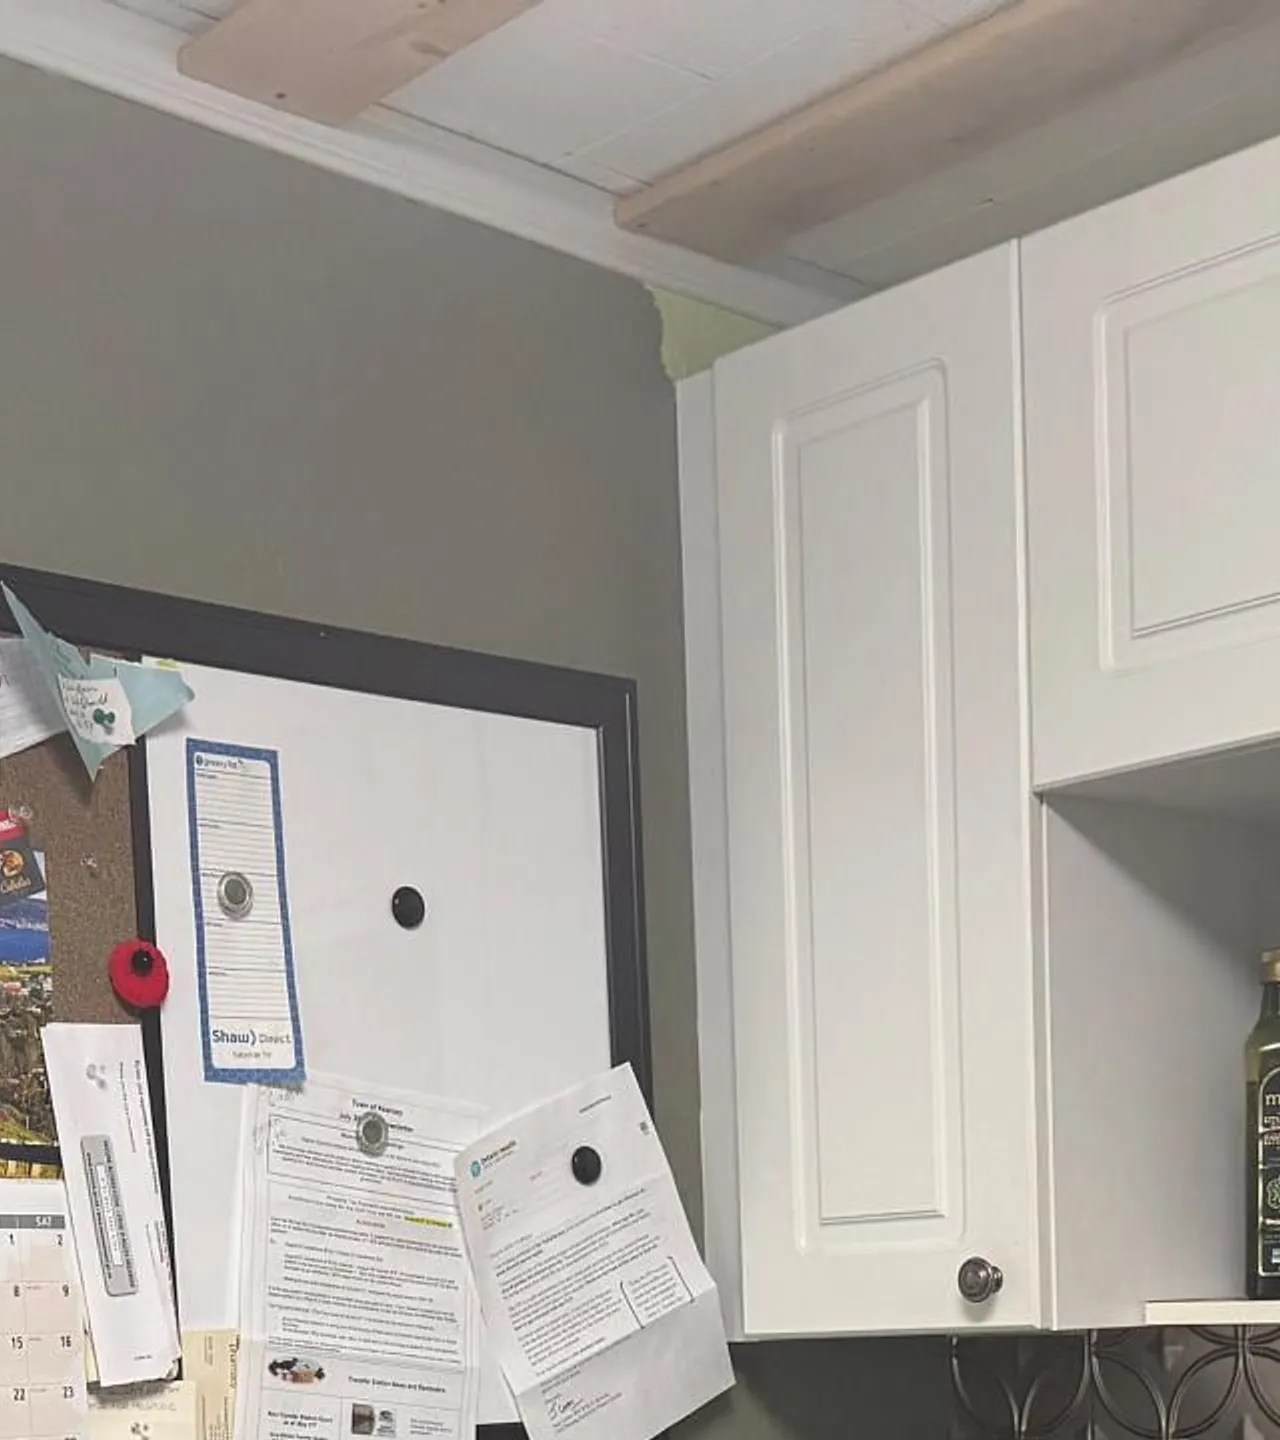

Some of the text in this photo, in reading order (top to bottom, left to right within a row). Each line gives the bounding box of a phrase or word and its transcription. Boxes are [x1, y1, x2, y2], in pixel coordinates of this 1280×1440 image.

[212, 1030, 250, 1045] Shaw
[35, 1216, 53, 1227] SAT
[11, 1336, 24, 1350] 15
[60, 1335, 72, 1348] 16
[13, 1387, 26, 1402] 22
[62, 1385, 75, 1399] 23
